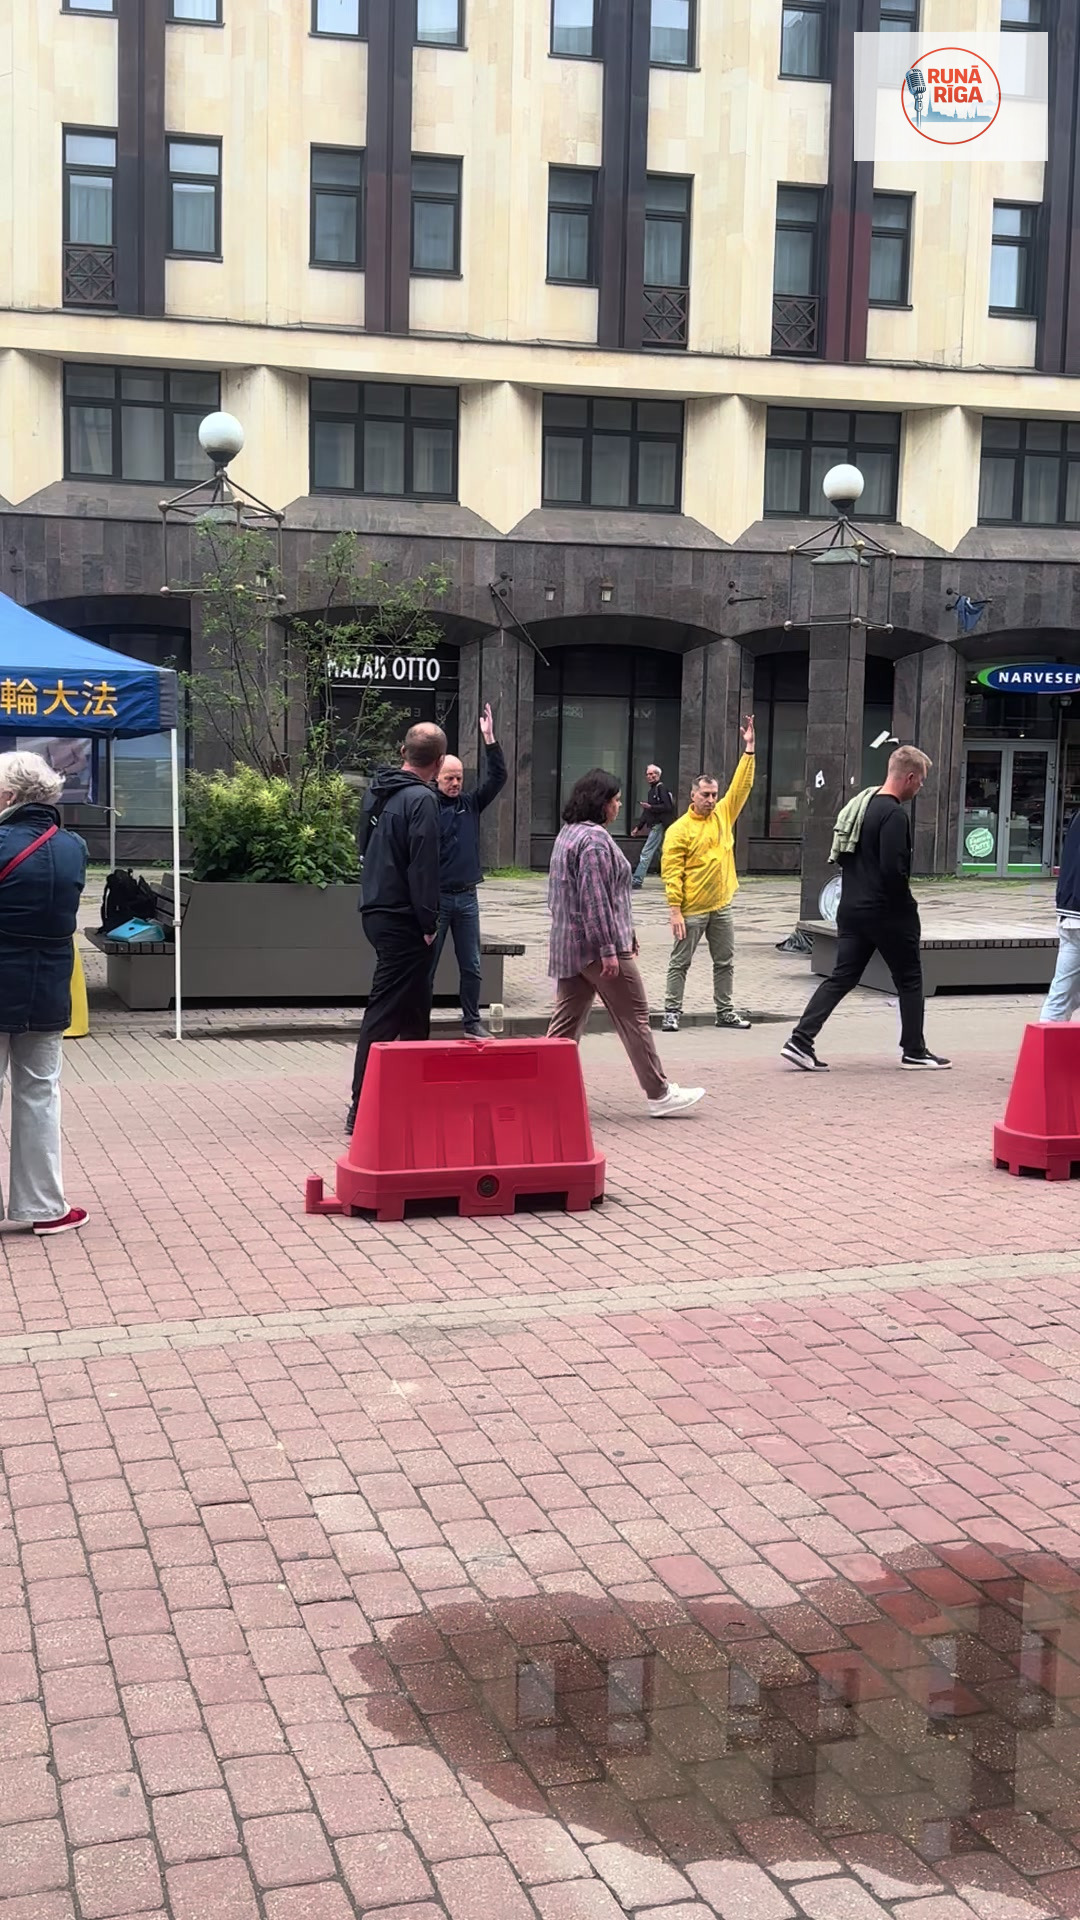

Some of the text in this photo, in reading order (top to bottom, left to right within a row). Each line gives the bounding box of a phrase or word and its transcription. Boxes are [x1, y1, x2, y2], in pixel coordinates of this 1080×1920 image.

[392, 657, 440, 682] OTTO
[0, 677, 118, 717] 輪大法
